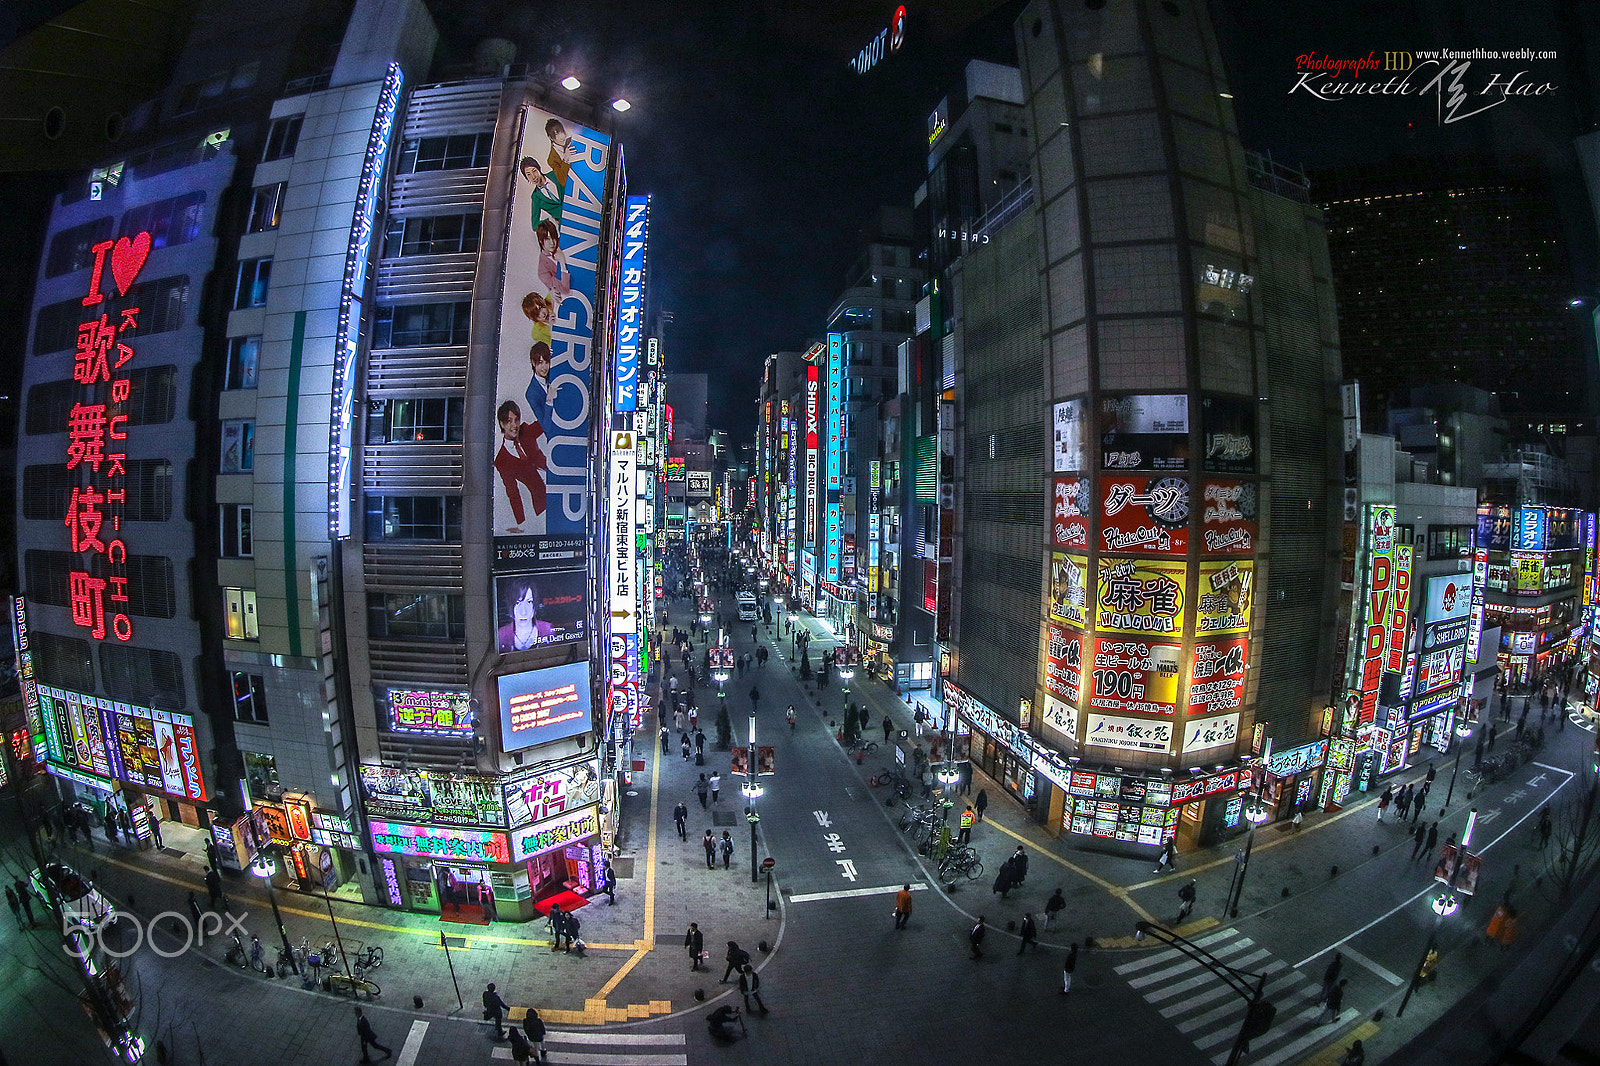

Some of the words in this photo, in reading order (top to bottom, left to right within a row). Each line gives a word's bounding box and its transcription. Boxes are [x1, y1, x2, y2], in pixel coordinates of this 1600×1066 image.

[624, 204, 646, 260] 747
[617, 267, 642, 404] カラオケグランド
[546, 290, 594, 522] GROUP
[807, 380, 818, 434] SHIDAX
[64, 313, 117, 640] 歌舞伎町
[107, 307, 140, 641] KABUKI-CHO
[808, 454, 816, 469] BIC
[807, 470, 815, 495] DRUG
[1104, 484, 1180, 516] ダーツ
[615, 459, 630, 597] マルハン新宿東宝ビル店
[1523, 511, 1539, 550] カラオケ
[1102, 576, 1180, 615] 麻雀
[1100, 612, 1175, 632] WELCOME
[1094, 653, 1153, 671] 生ビールが
[1100, 640, 1149, 656] いつでも
[1090, 736, 1119, 745] YAKINIKU
[1107, 724, 1124, 733] 焼肉
[522, 815, 595, 855] 無料案内所
